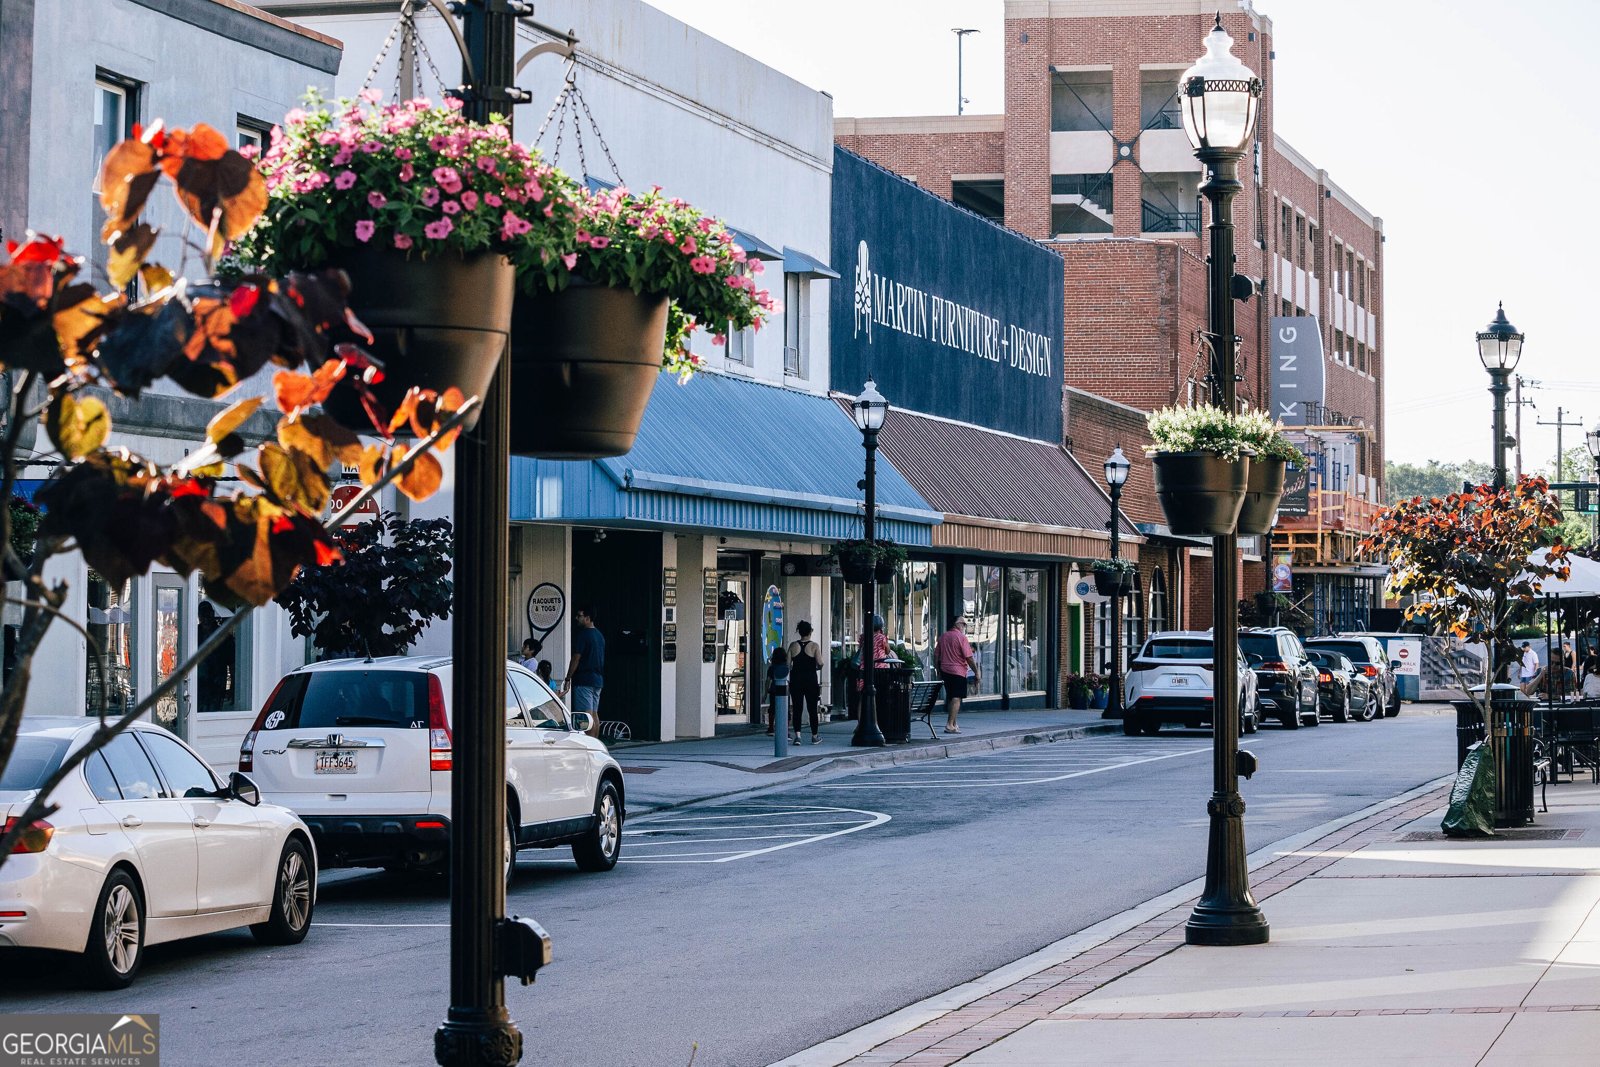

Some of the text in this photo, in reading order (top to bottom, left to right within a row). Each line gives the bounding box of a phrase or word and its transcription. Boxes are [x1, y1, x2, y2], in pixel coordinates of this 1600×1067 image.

[873, 273, 927, 339] MARTIN
[932, 295, 1000, 363] FURNITURE
[1010, 324, 1051, 377] DESIGN
[320, 756, 353, 768] TFF3645
